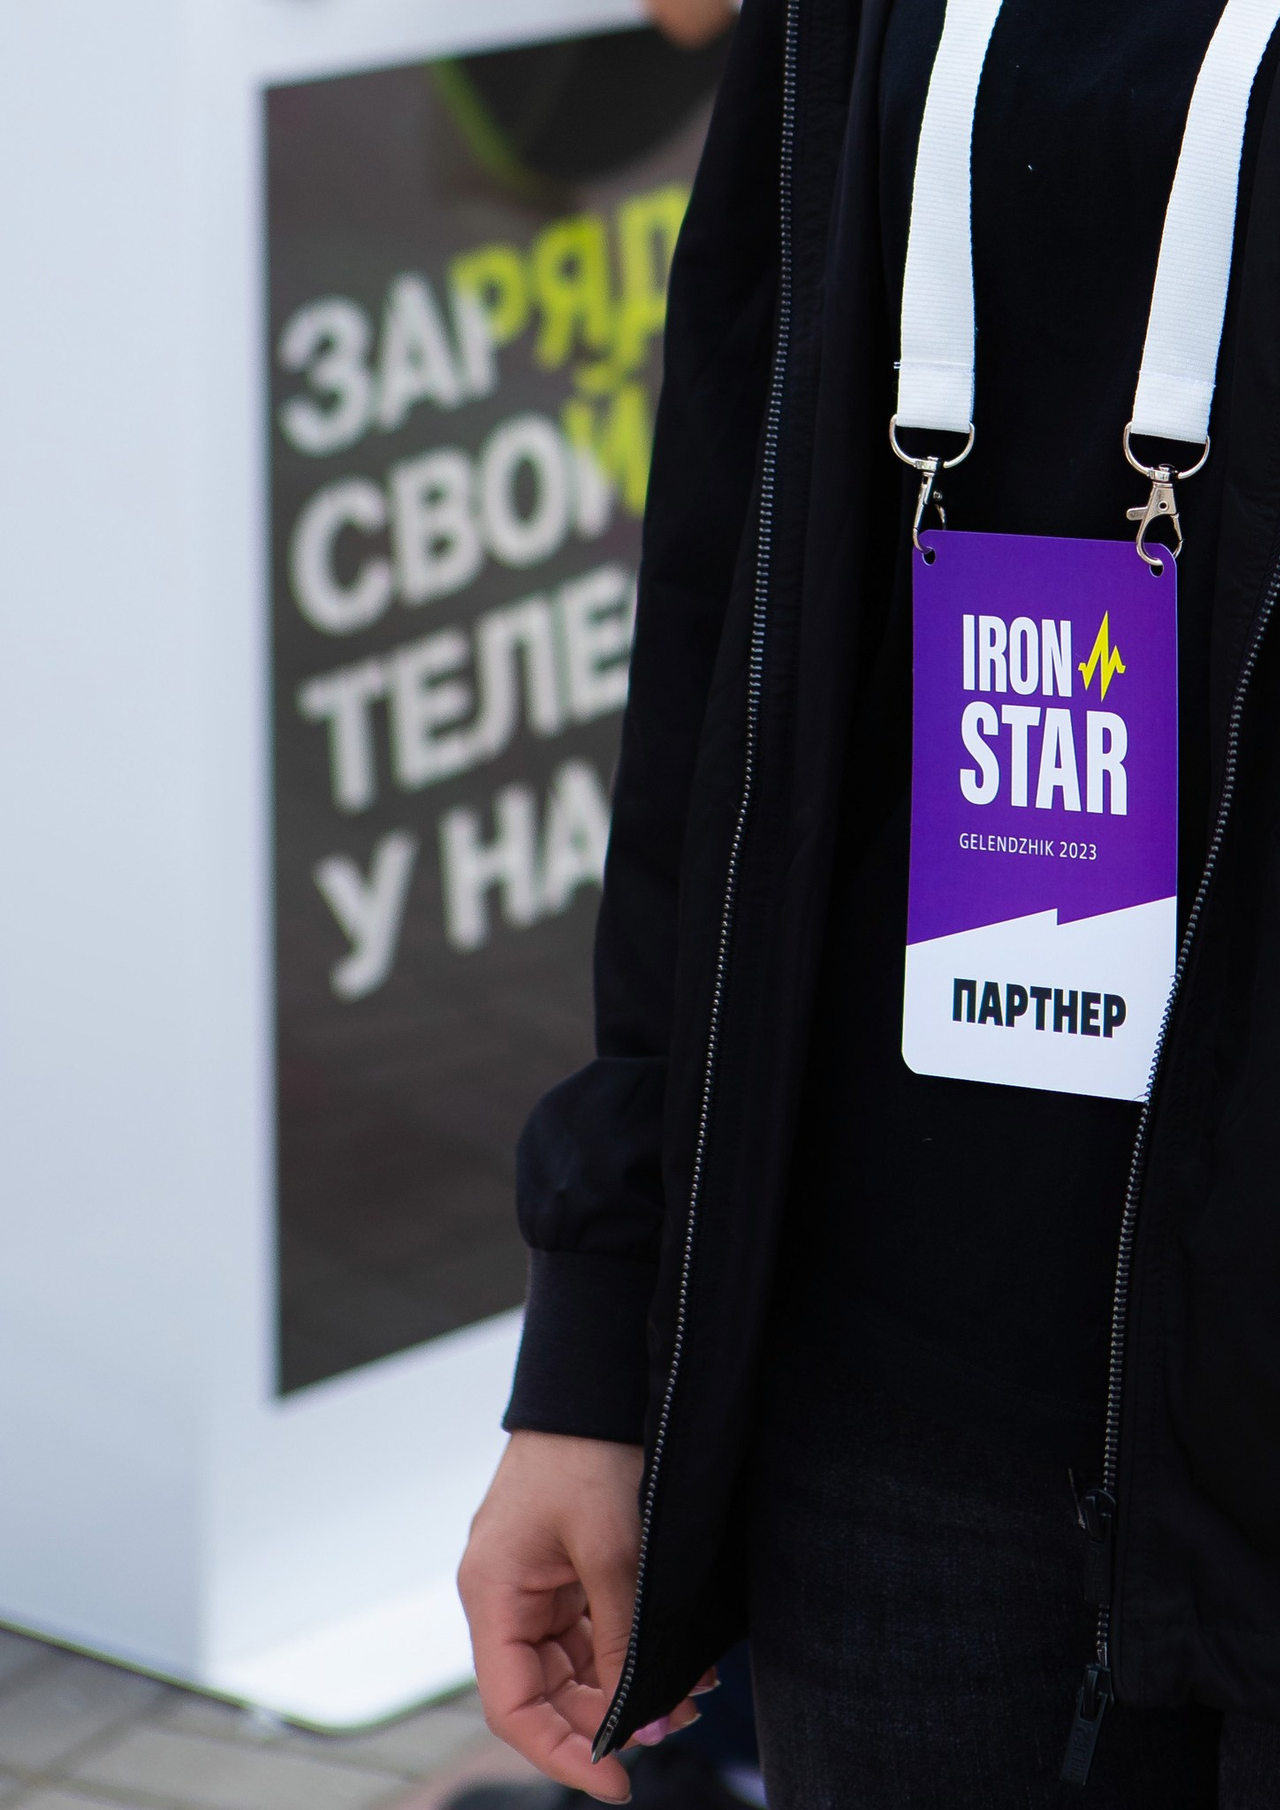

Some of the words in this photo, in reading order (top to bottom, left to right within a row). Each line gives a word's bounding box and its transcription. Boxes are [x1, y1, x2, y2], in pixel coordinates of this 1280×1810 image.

[962, 613, 1072, 697] IRON
[959, 700, 1128, 816] STAR
[959, 832, 1054, 857] GELENDZHIK
[1059, 841, 1097, 860] 2023
[314, 830, 418, 1002] У
[951, 977, 1127, 1038] ПАРТНЕР
